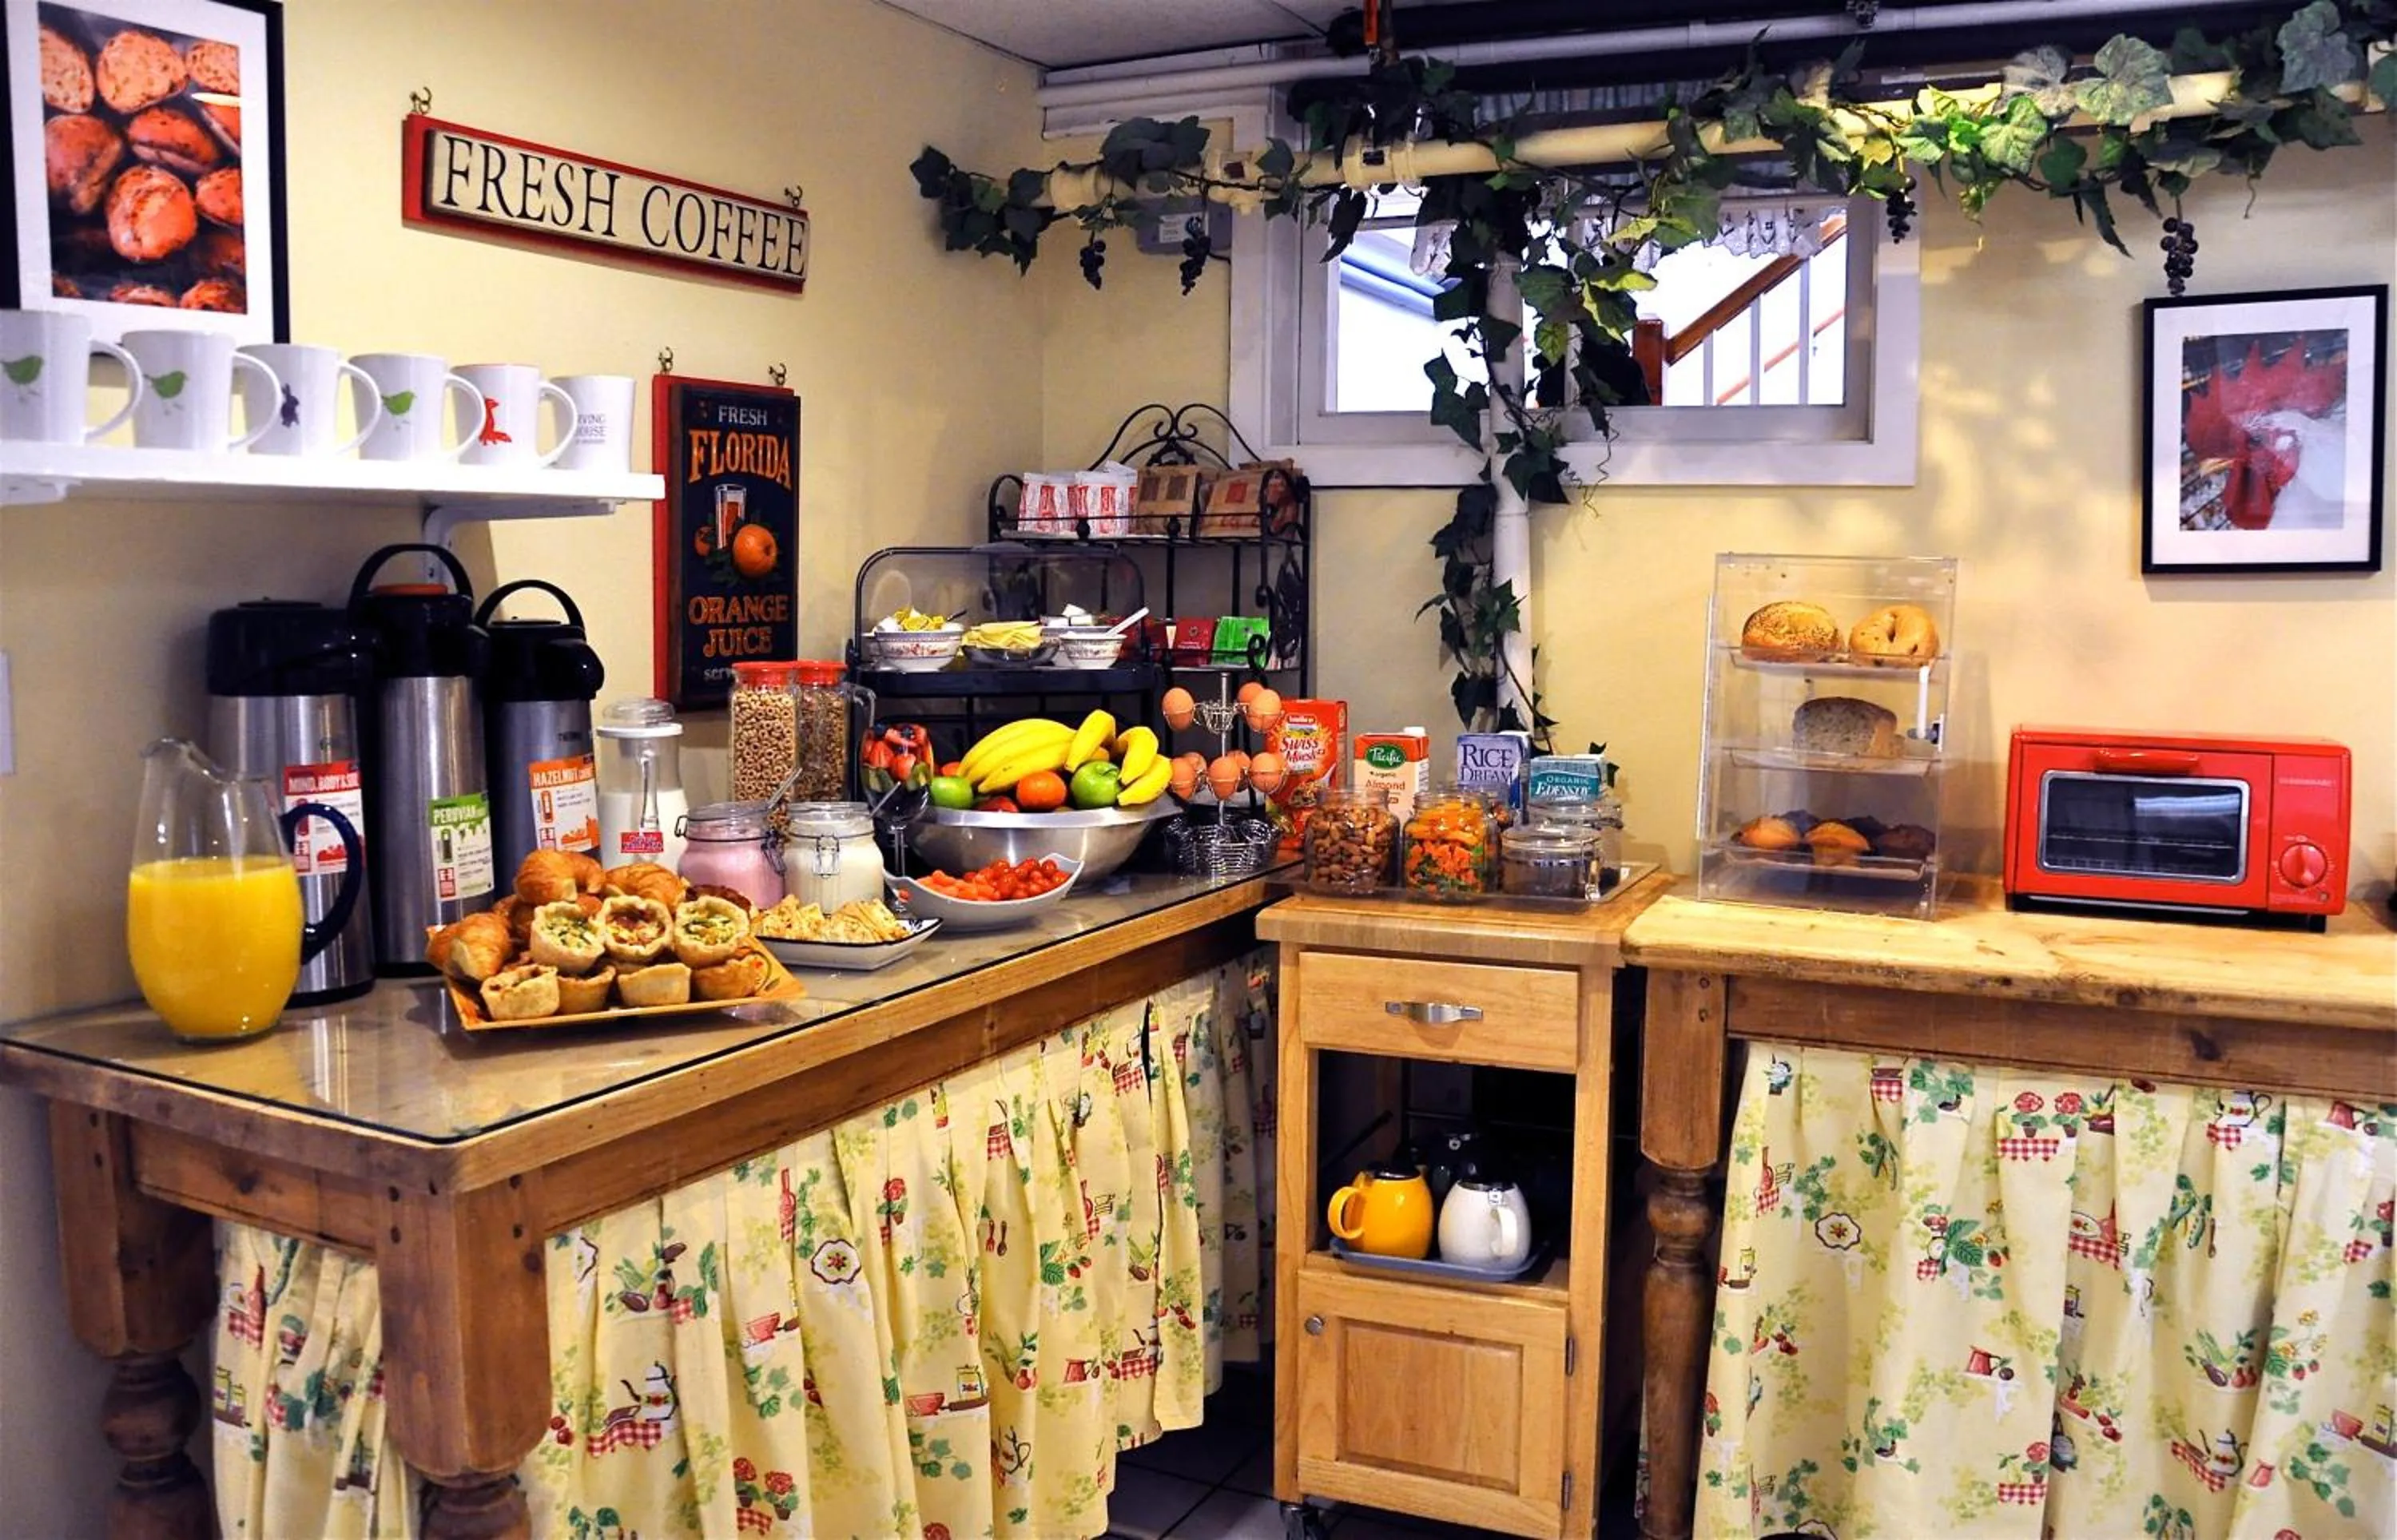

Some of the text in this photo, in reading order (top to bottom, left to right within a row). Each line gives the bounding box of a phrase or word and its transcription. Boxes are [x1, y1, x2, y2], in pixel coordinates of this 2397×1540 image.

[440, 135, 806, 277] FRESH COFFEE
[718, 404, 769, 427] FRESH
[688, 429, 793, 490] FLORIDA
[689, 595, 789, 625] ORANGE
[702, 626, 773, 657] JUICE
[1461, 744, 1513, 768] RICE
[533, 767, 578, 786] HAZELNUT
[1365, 779, 1406, 791] Almond
[1461, 767, 1513, 784] DREAM
